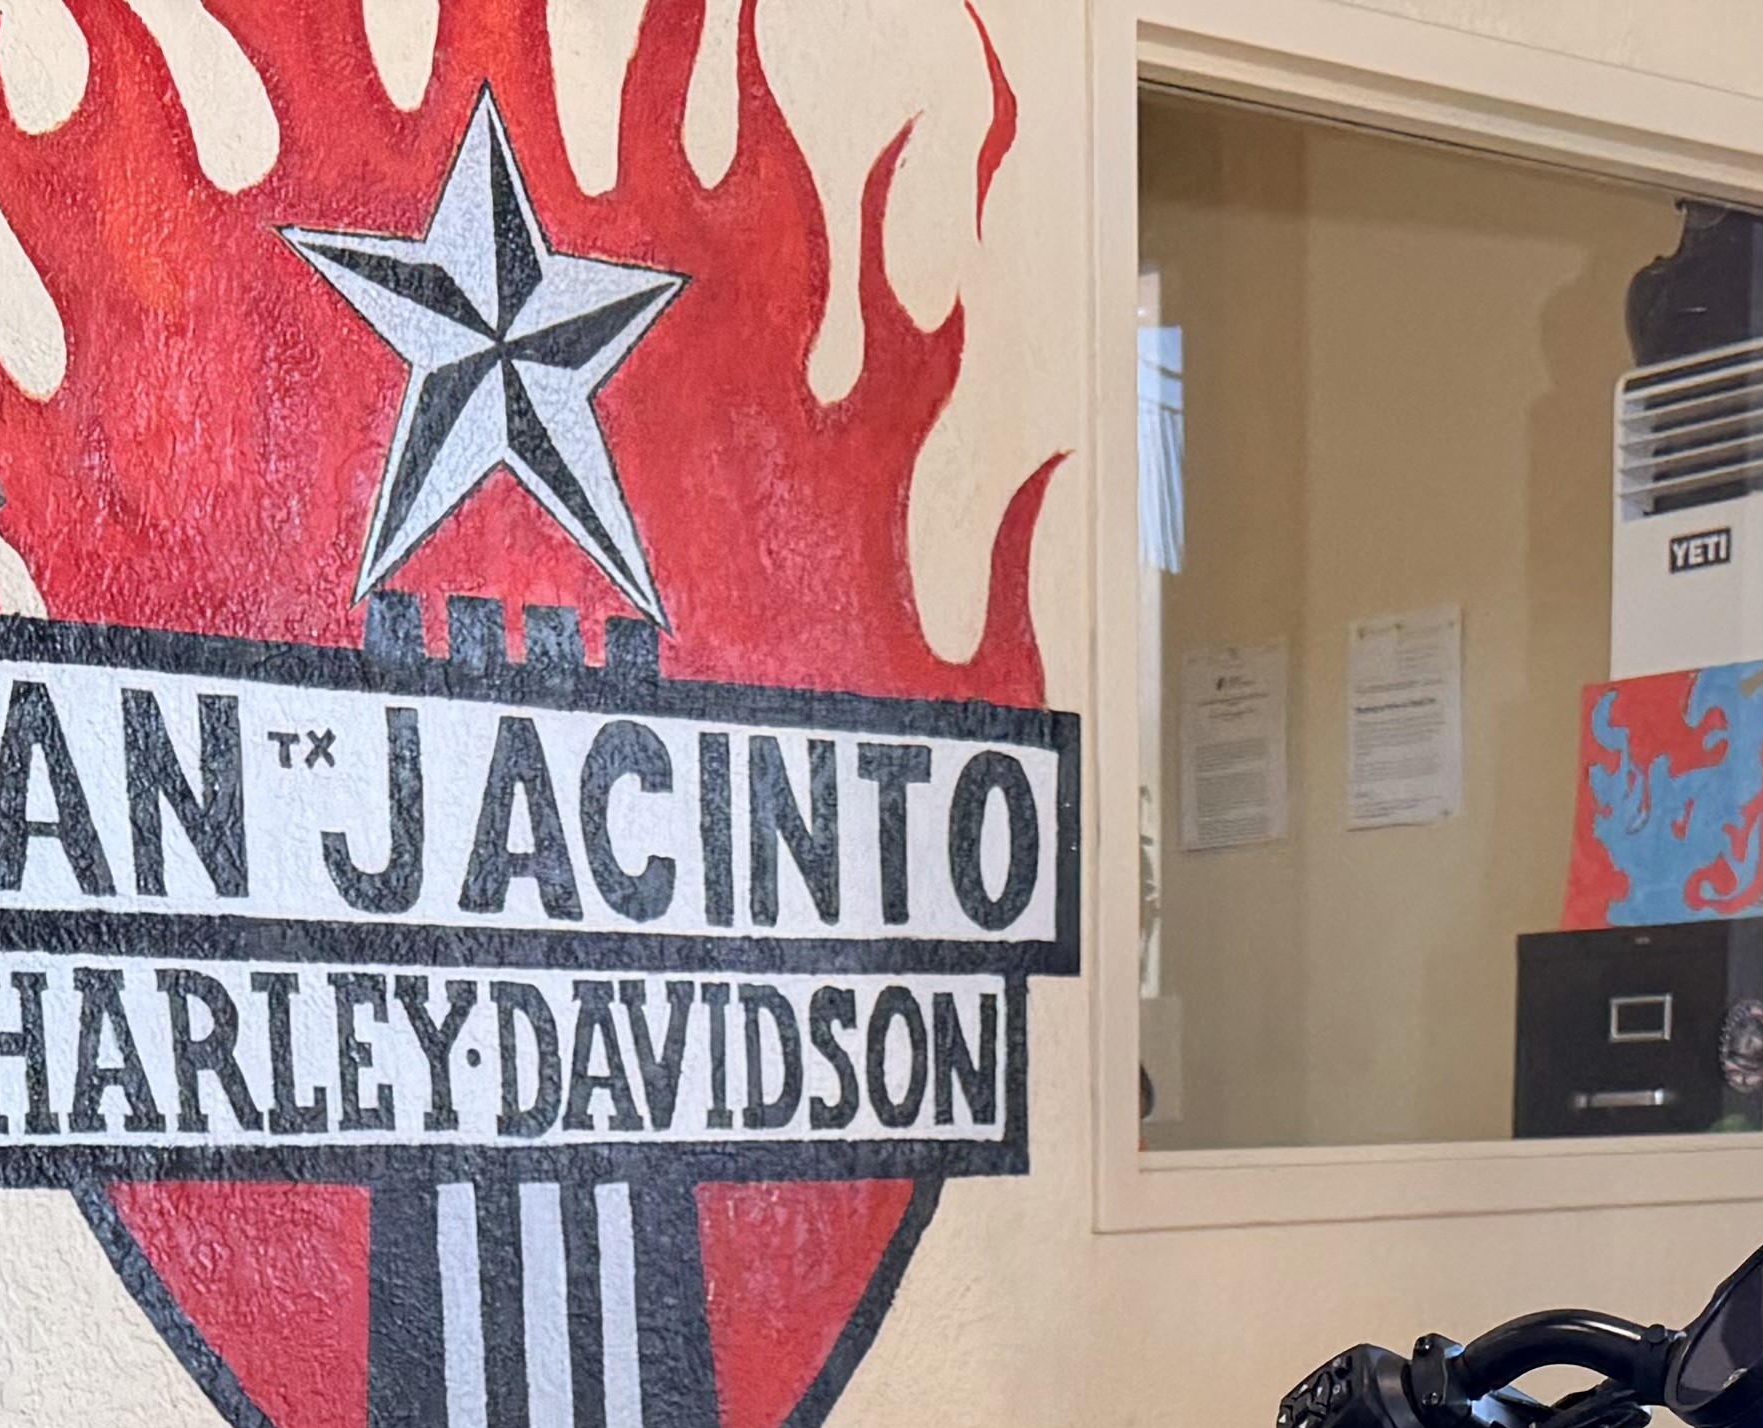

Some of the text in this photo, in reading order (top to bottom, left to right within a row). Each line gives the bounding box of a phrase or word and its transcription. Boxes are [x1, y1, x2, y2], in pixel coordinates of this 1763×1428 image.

[1672, 533, 1727, 568] YETI
[267, 727, 336, 771] TX
[320, 706, 1041, 932] JACINTO
